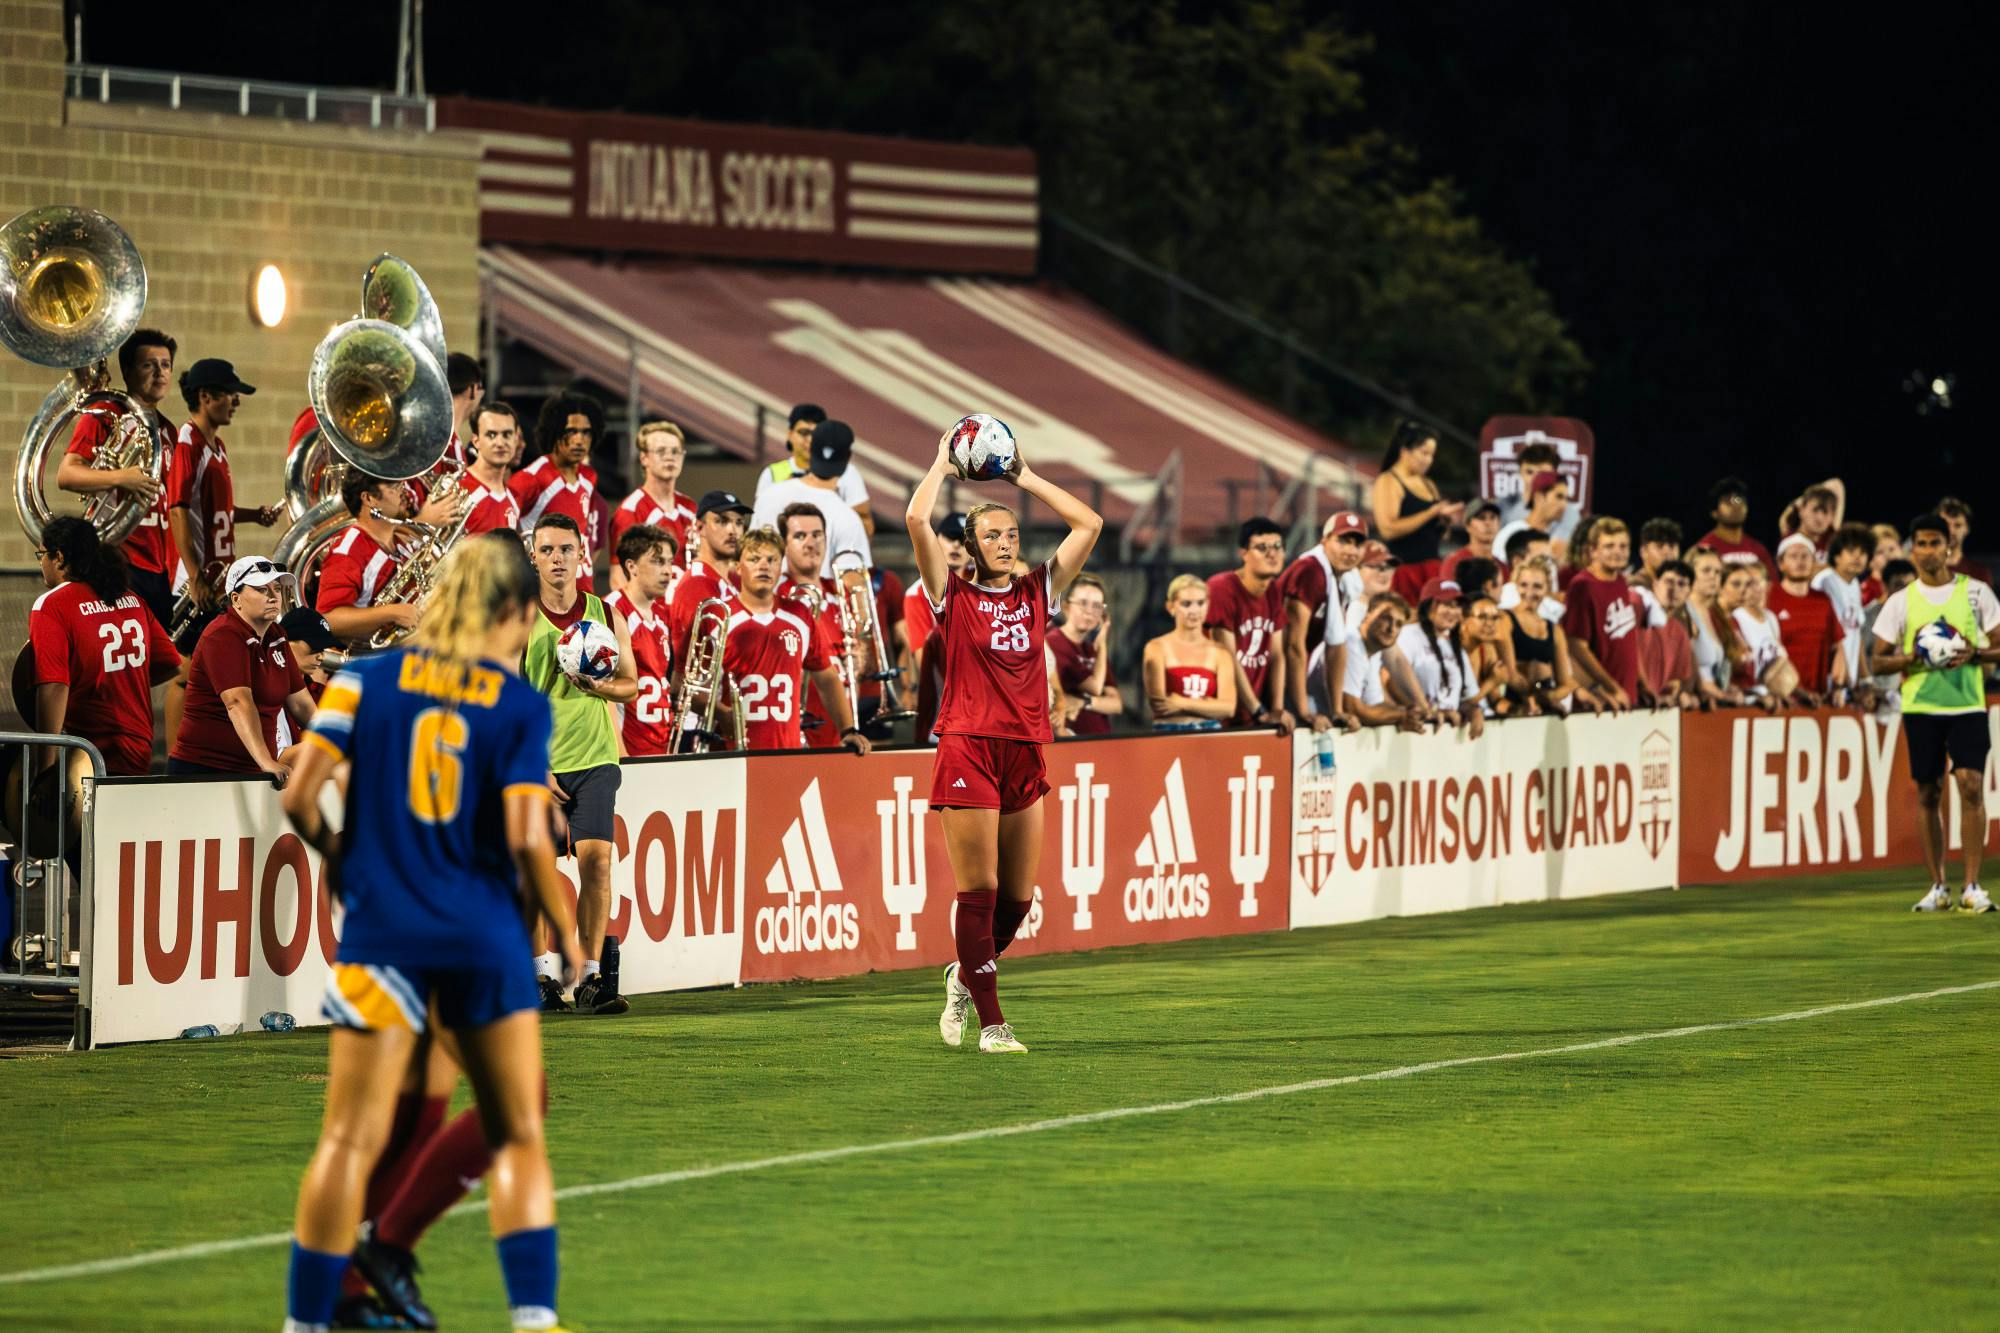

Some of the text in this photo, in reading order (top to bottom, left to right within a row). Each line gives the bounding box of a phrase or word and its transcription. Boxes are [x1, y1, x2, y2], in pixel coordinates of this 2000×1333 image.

[588, 139, 834, 232] INDIANA SOCCER
[98, 618, 146, 673] 23
[990, 619, 1030, 652] 28
[739, 673, 794, 723] 23
[407, 705, 470, 826] 6
[1713, 712, 1901, 873] JERRY
[1344, 762, 1634, 871] CRIMSON GUARD
[754, 890, 860, 955] adidas
[1123, 862, 1211, 923] adidas
